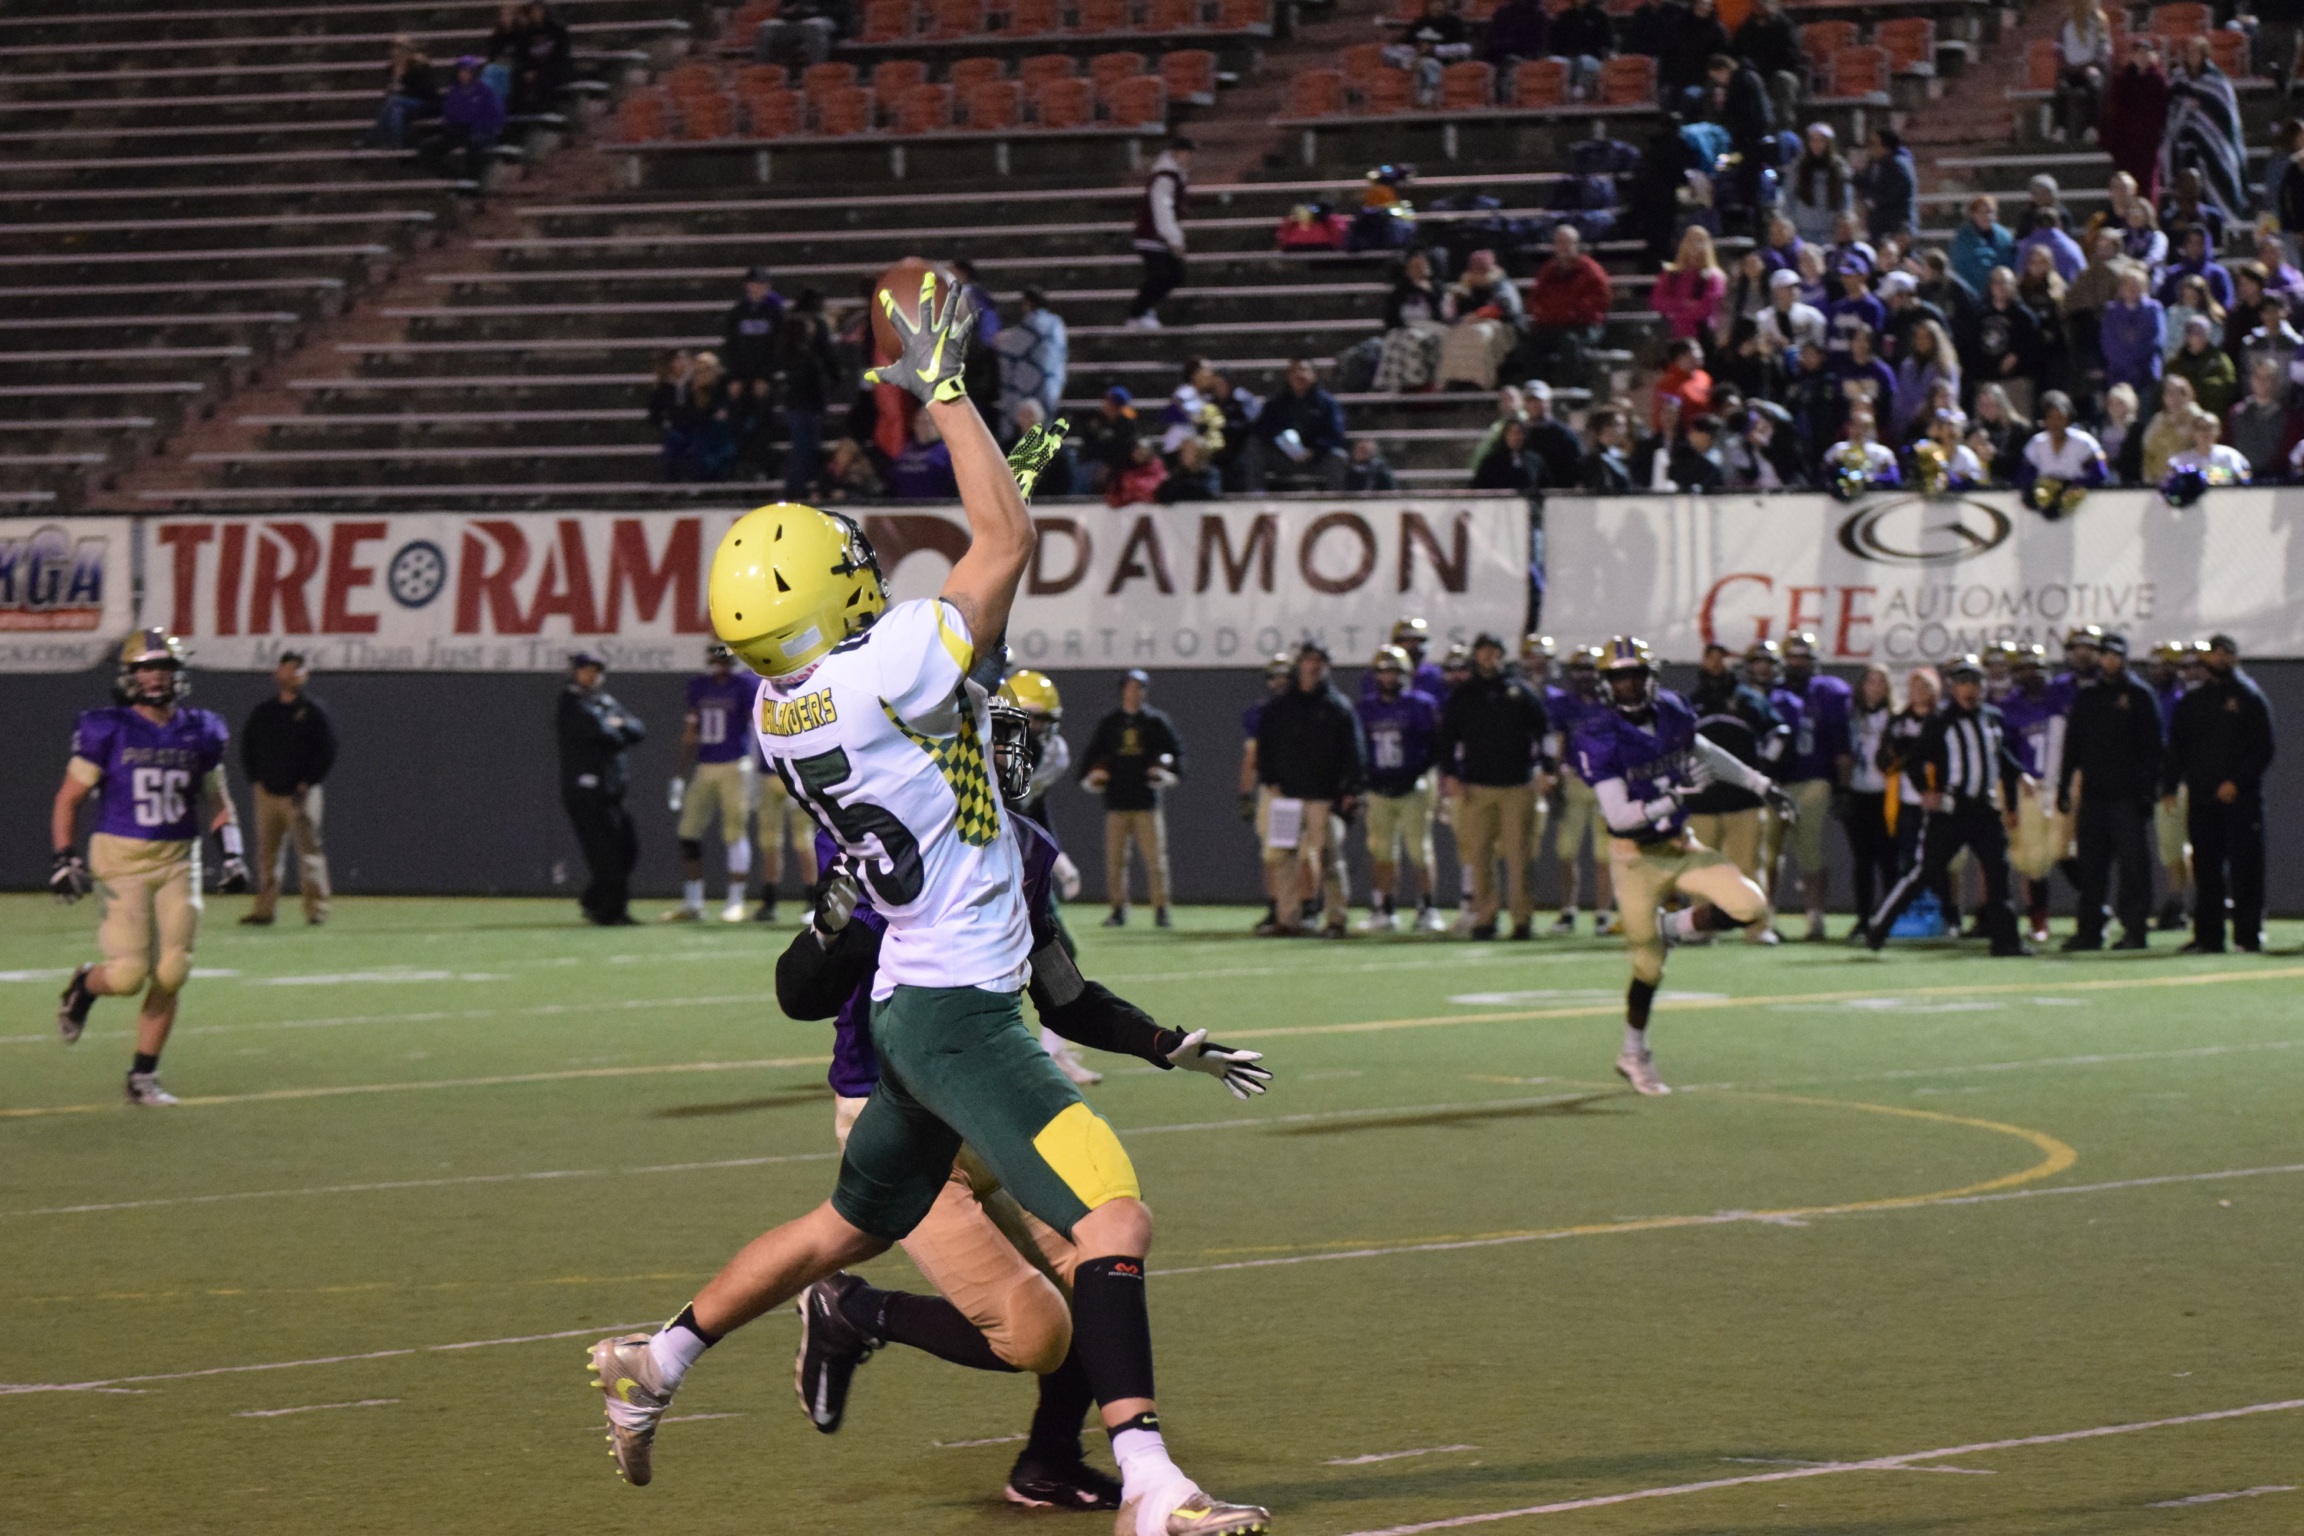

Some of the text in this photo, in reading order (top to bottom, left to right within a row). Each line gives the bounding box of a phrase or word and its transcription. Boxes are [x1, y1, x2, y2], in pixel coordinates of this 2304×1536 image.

[159, 517, 738, 637] TIRE RAM
[1028, 511, 1470, 596] DAMON
[1697, 572, 1878, 658] GEE
[1883, 583, 2157, 622] AUTOMOTIVE
[1884, 621, 2132, 658] COMPAN
